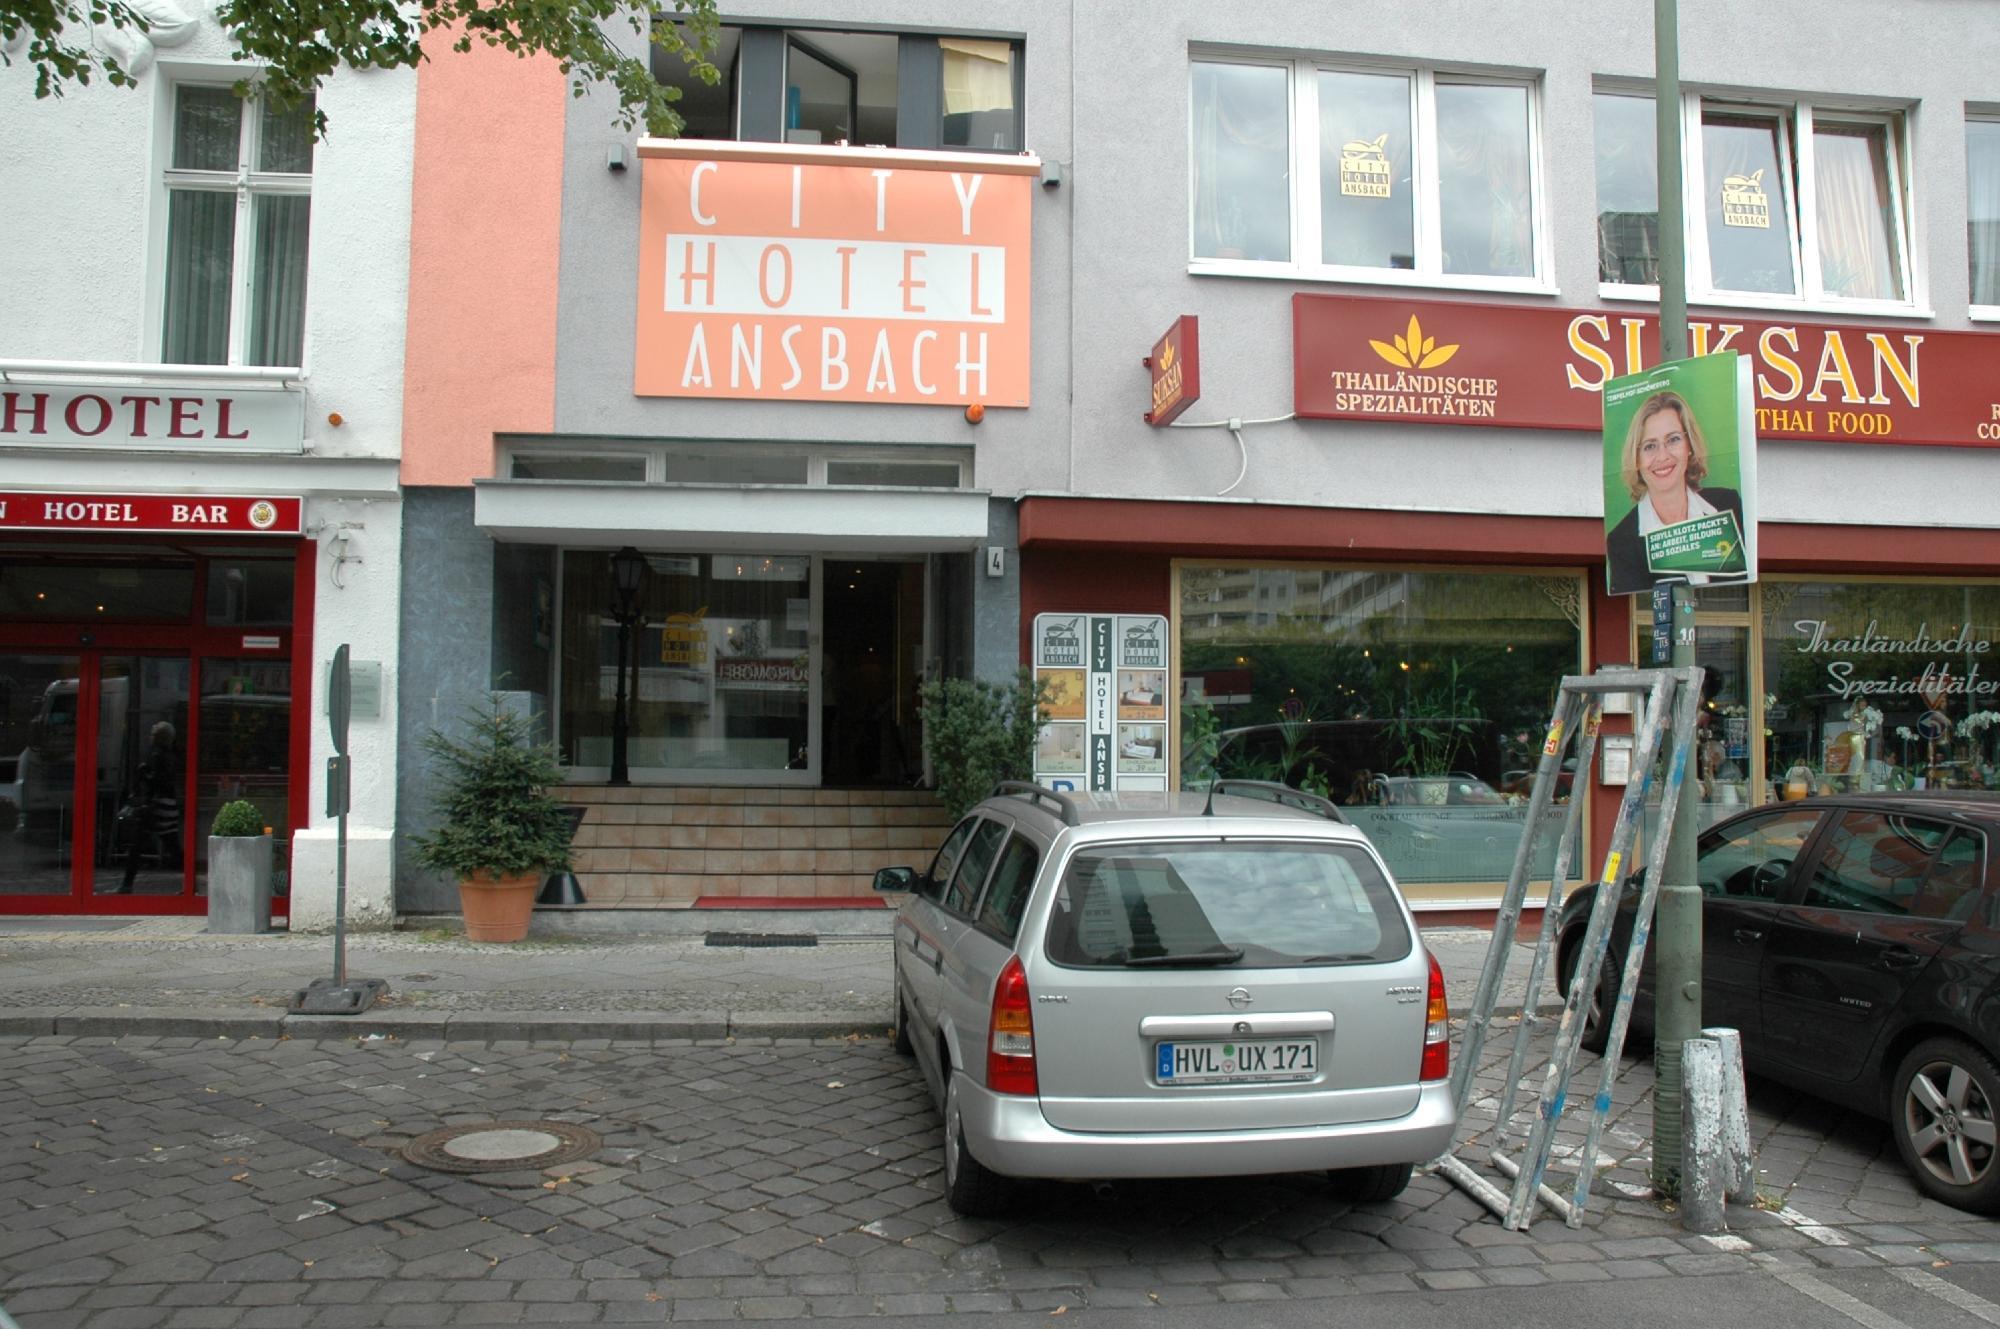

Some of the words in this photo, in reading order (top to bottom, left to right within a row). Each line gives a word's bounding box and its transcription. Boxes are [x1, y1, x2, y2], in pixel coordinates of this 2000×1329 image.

[1344, 161, 1386, 172] CITY
[690, 162, 983, 235] CITY
[1345, 184, 1387, 195] ANSBACH
[679, 241, 992, 316] HOTEL
[681, 321, 989, 397] ANSBACH
[1331, 371, 1498, 397] THAILÄNDISCHE
[1, 392, 250, 439] HOTEL
[1335, 393, 1496, 417] SPEZIALITÄTEN
[1755, 408, 1814, 433] THAI
[1828, 411, 1892, 435] FOOD
[44, 502, 138, 522] HOTEL
[172, 504, 228, 524] BAR
[1650, 530, 1673, 543] SIBYLL
[1673, 525, 1697, 536] KLOTZ
[1697, 516, 1729, 531] PACKT'S
[1688, 527, 1723, 541] BILDUNG
[990, 553, 1001, 571] 4
[1651, 551, 1665, 560] UND
[1097, 622, 1106, 669] CITY
[1793, 619, 1991, 653] Thailändische
[1097, 677, 1106, 730] HOTEL
[1162, 1064, 1170, 1073] D
[1175, 1047, 1219, 1073] HVL
[1238, 1046, 1267, 1071] UX
[1273, 1044, 1314, 1069] 171
